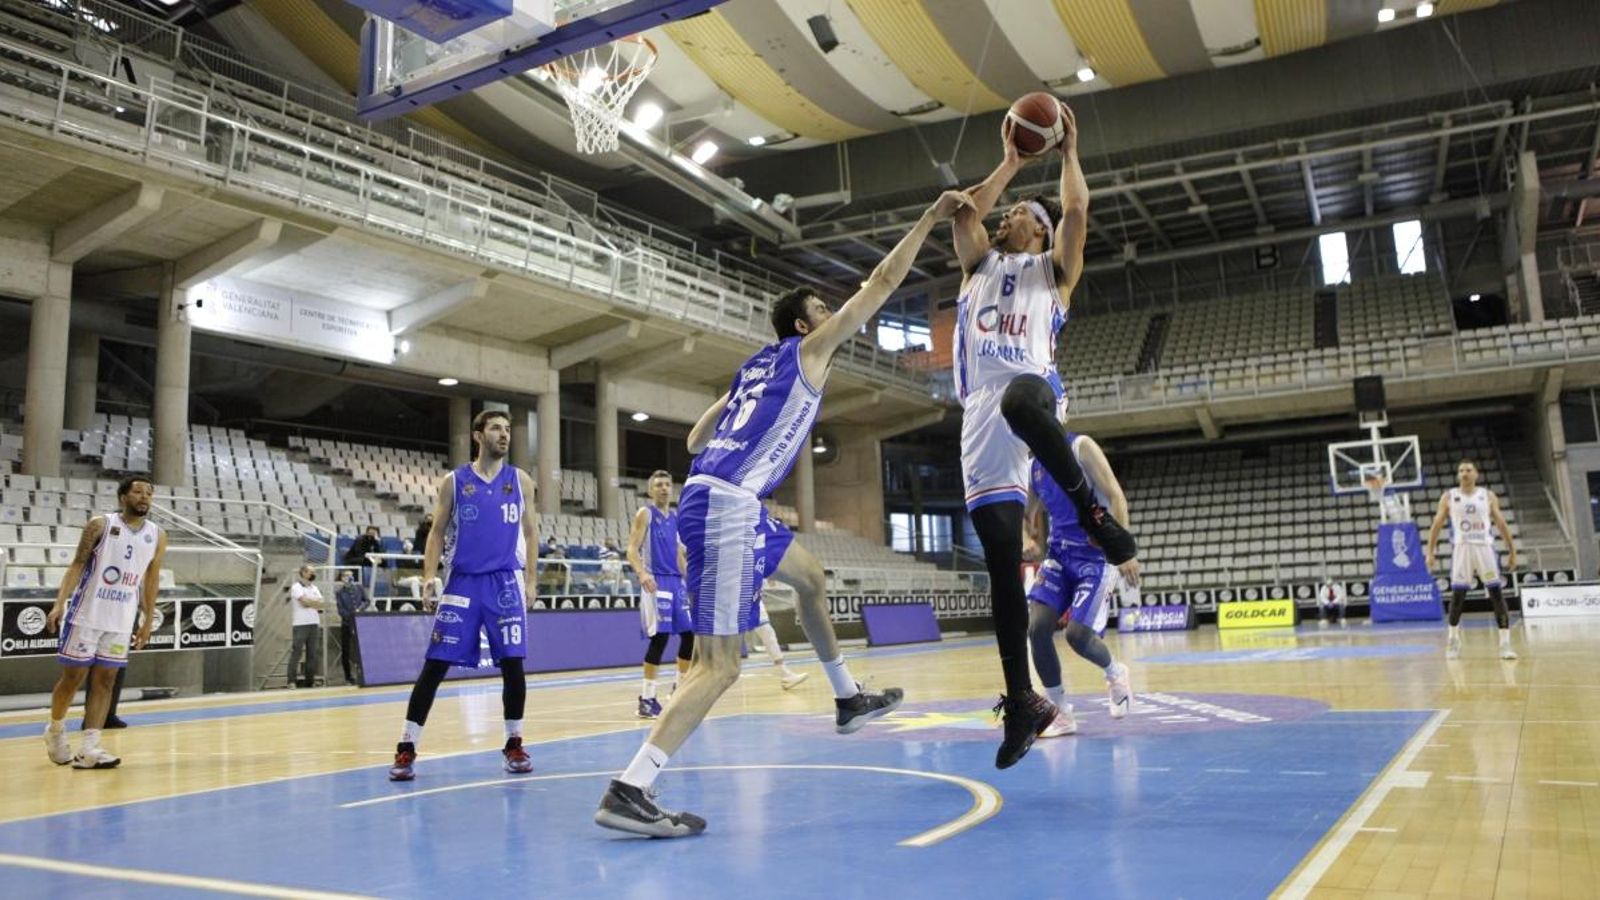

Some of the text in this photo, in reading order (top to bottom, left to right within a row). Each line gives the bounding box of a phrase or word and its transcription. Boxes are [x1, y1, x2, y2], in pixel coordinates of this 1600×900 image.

[1002, 274, 1016, 297] 6
[221, 290, 280, 311] GENERALITAT
[222, 301, 280, 321] VALENCIANA
[299, 308, 326, 321] CENTRE
[124, 544, 134, 560] 3
[1373, 583, 1433, 595] GENERALITAT
[1375, 593, 1433, 603] VALENCIANA
[1225, 608, 1287, 620] GOLDCAR
[500, 623, 522, 646] 19
